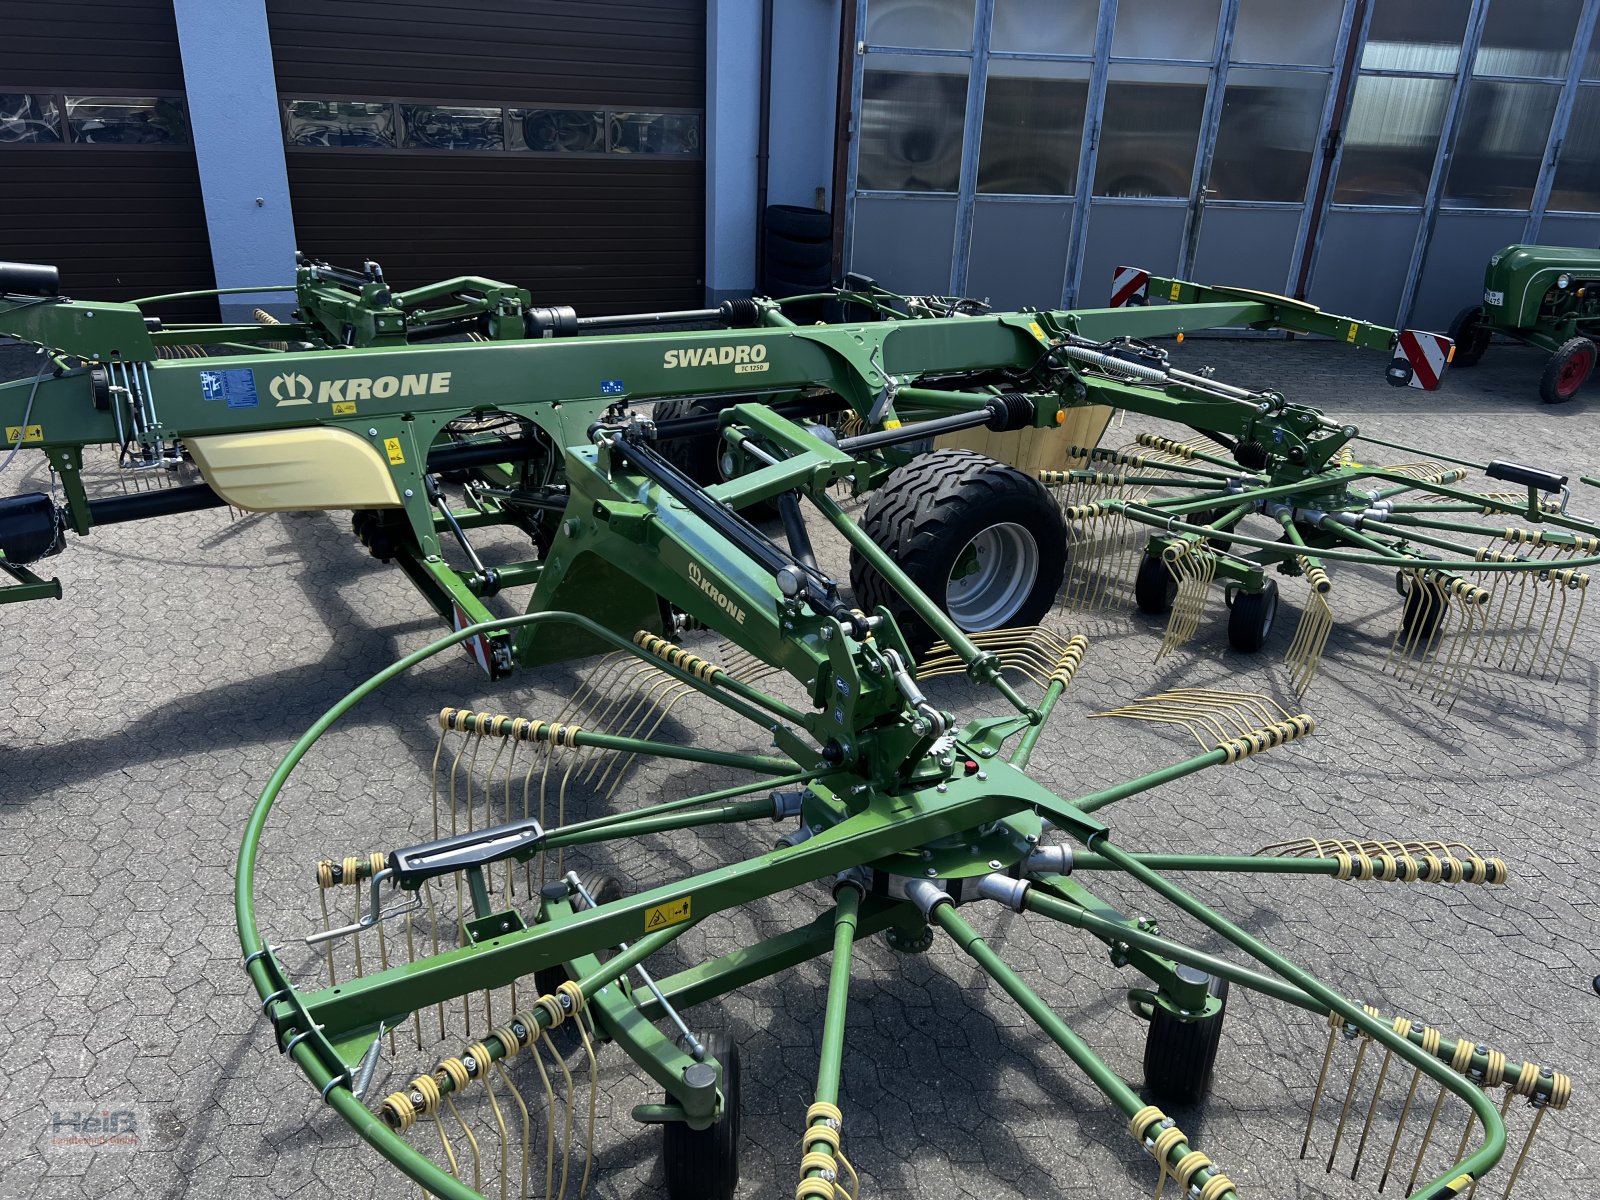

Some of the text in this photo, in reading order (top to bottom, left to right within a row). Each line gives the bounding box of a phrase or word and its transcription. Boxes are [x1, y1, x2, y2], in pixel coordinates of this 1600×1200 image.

[663, 344, 767, 369] SWADRO
[317, 371, 452, 404] KRONE
[700, 577, 746, 625] KRONE
